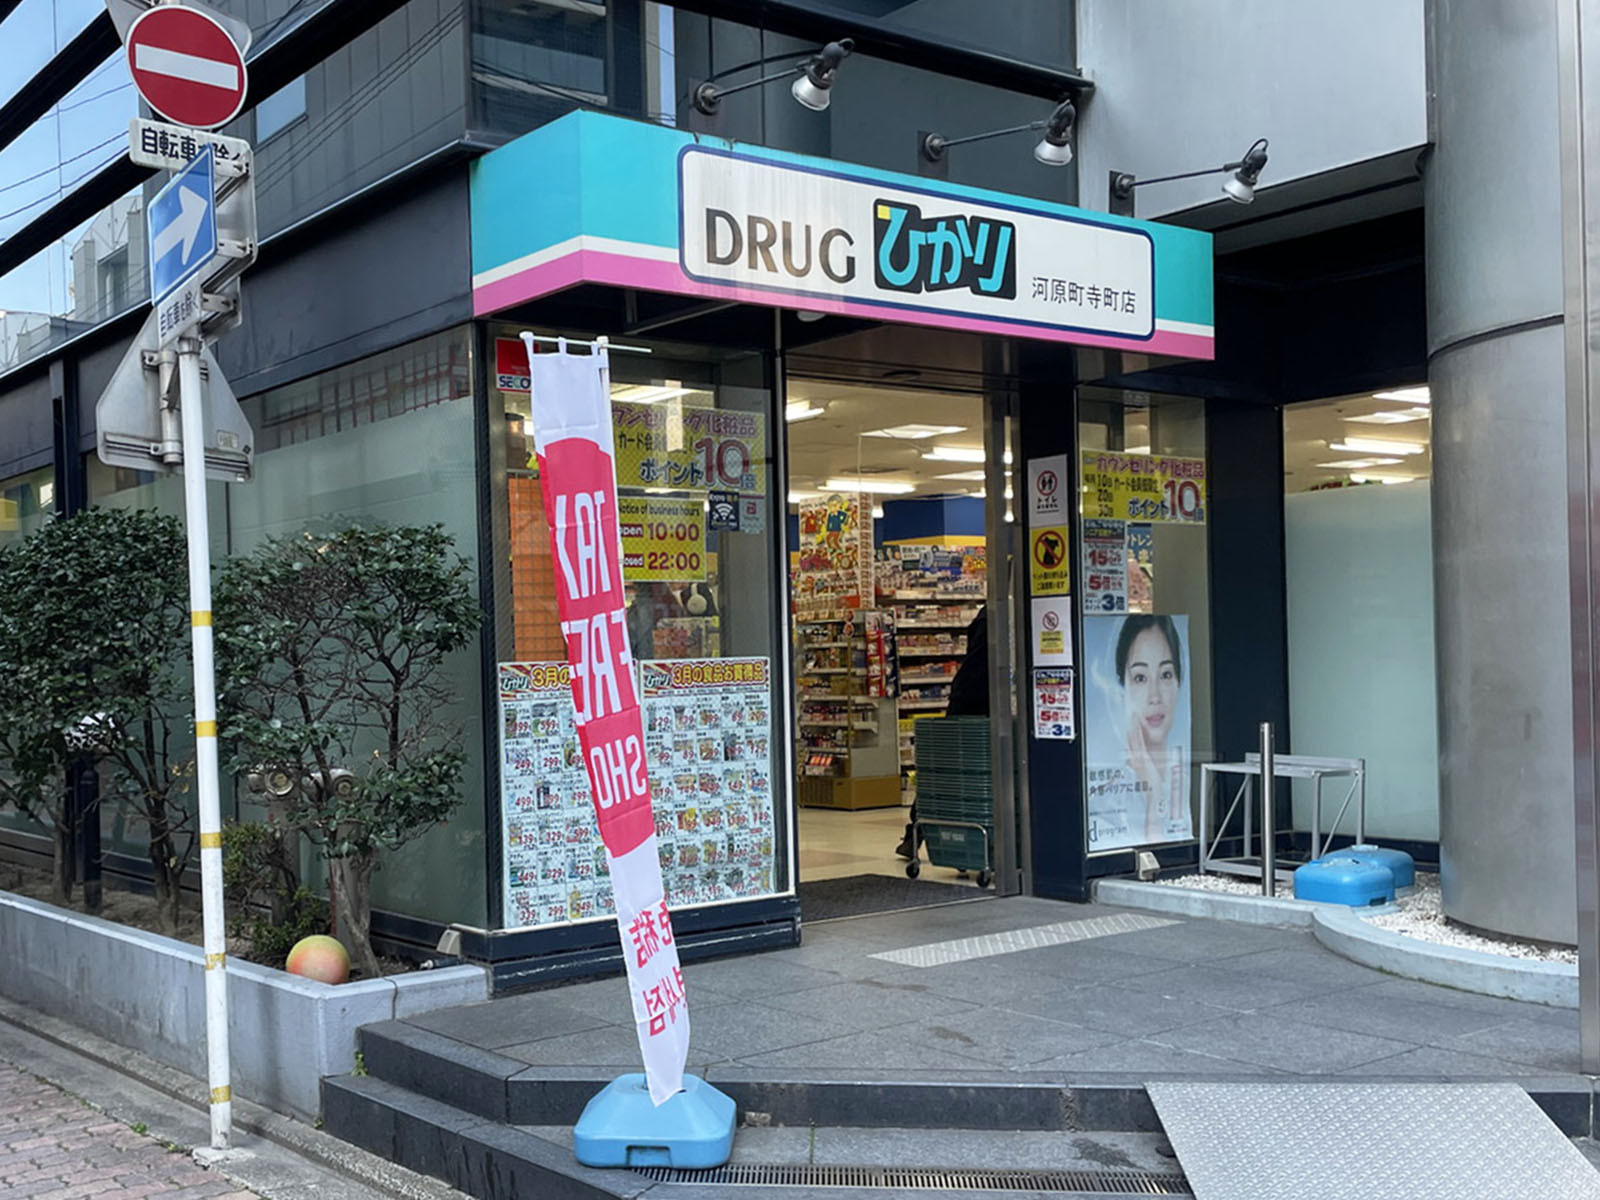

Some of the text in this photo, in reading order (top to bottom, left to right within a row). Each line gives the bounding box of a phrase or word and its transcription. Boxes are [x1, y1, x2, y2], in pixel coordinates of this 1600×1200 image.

[141, 127, 240, 163] 自転車
[706, 203, 1136, 314] DRUG ひかり 河原町寺町店
[499, 375, 531, 390] SECO
[648, 522, 700, 541] 10:00
[648, 552, 700, 571] 22:00
[532, 666, 571, 688] 3月の
